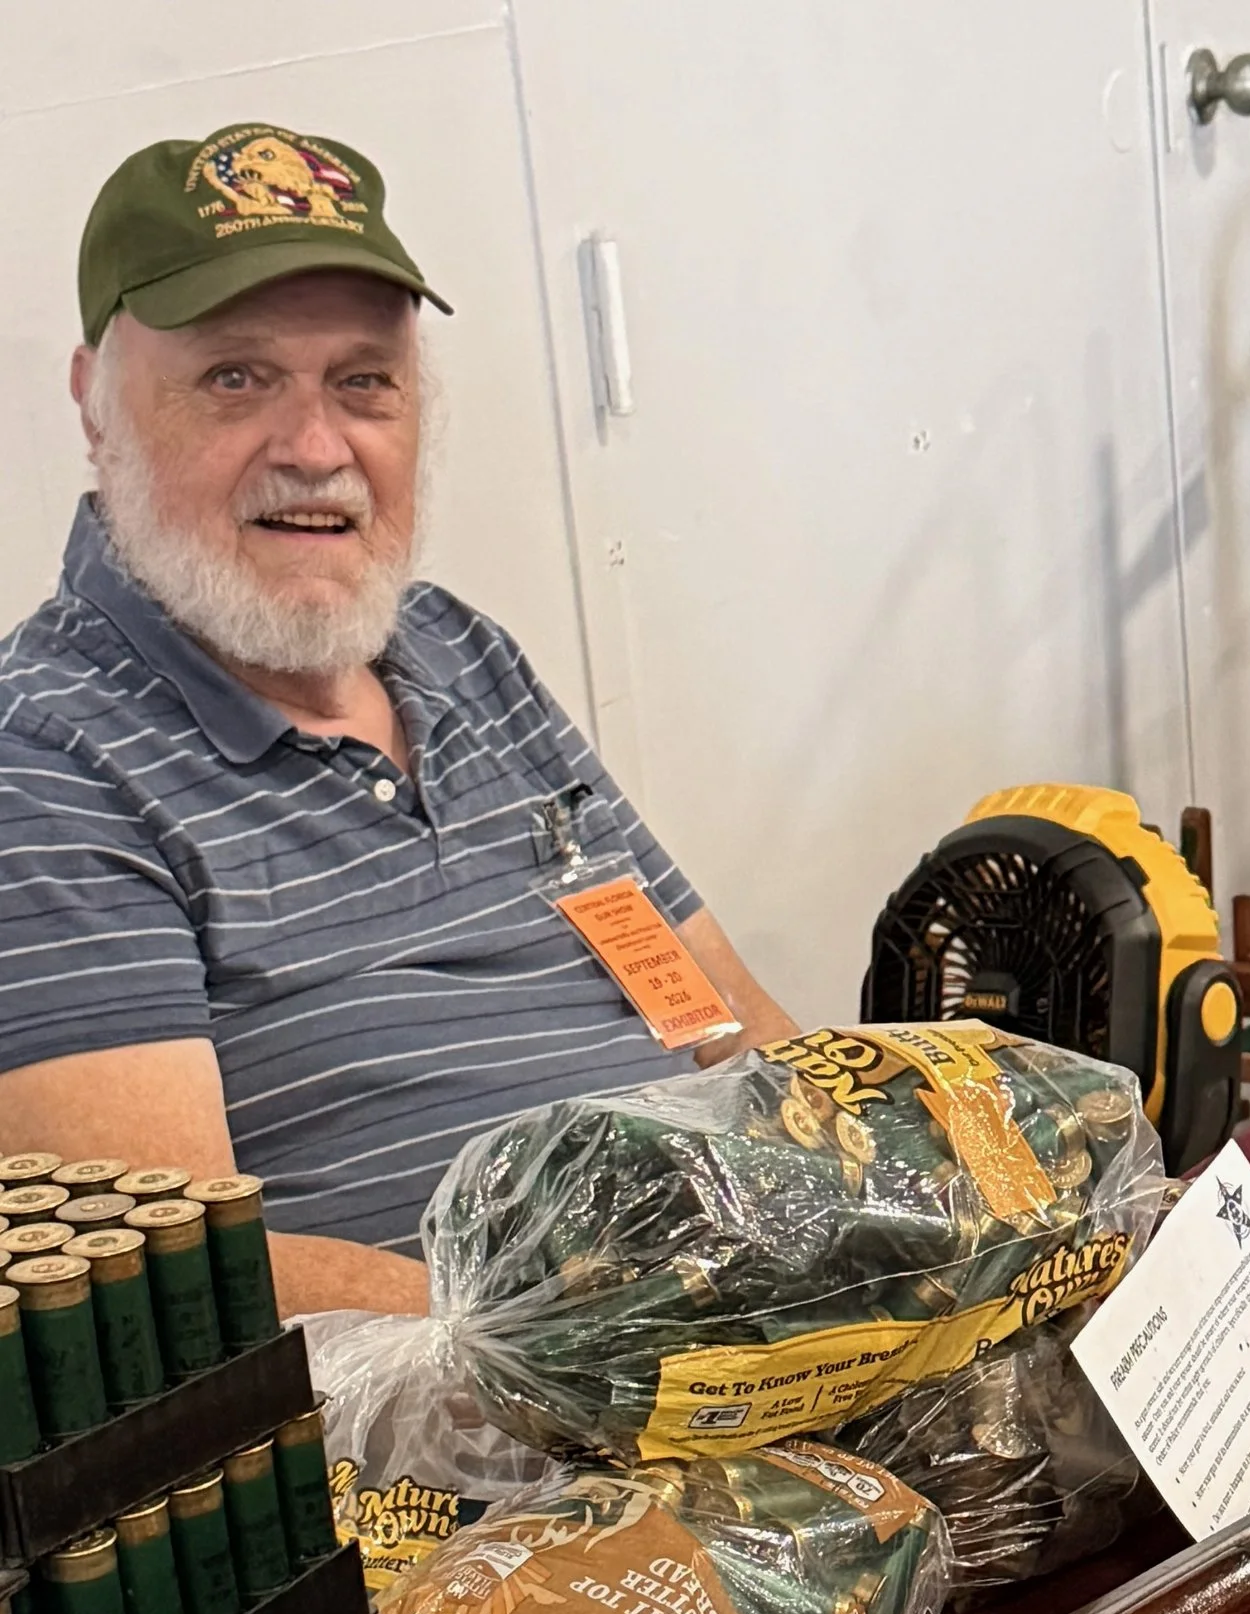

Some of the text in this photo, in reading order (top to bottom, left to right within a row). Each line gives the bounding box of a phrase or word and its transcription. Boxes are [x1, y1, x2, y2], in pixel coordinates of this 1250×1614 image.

[198, 200, 226, 218] 1776
[623, 950, 681, 976] SEPTEMBER
[662, 1003, 723, 1033] EXHIBITOR
[689, 1382, 728, 1396] Get
[732, 1382, 755, 1396] To
[758, 1370, 812, 1391] Know
[815, 1357, 857, 1379] Your
[569, 1576, 628, 1609] TOP
